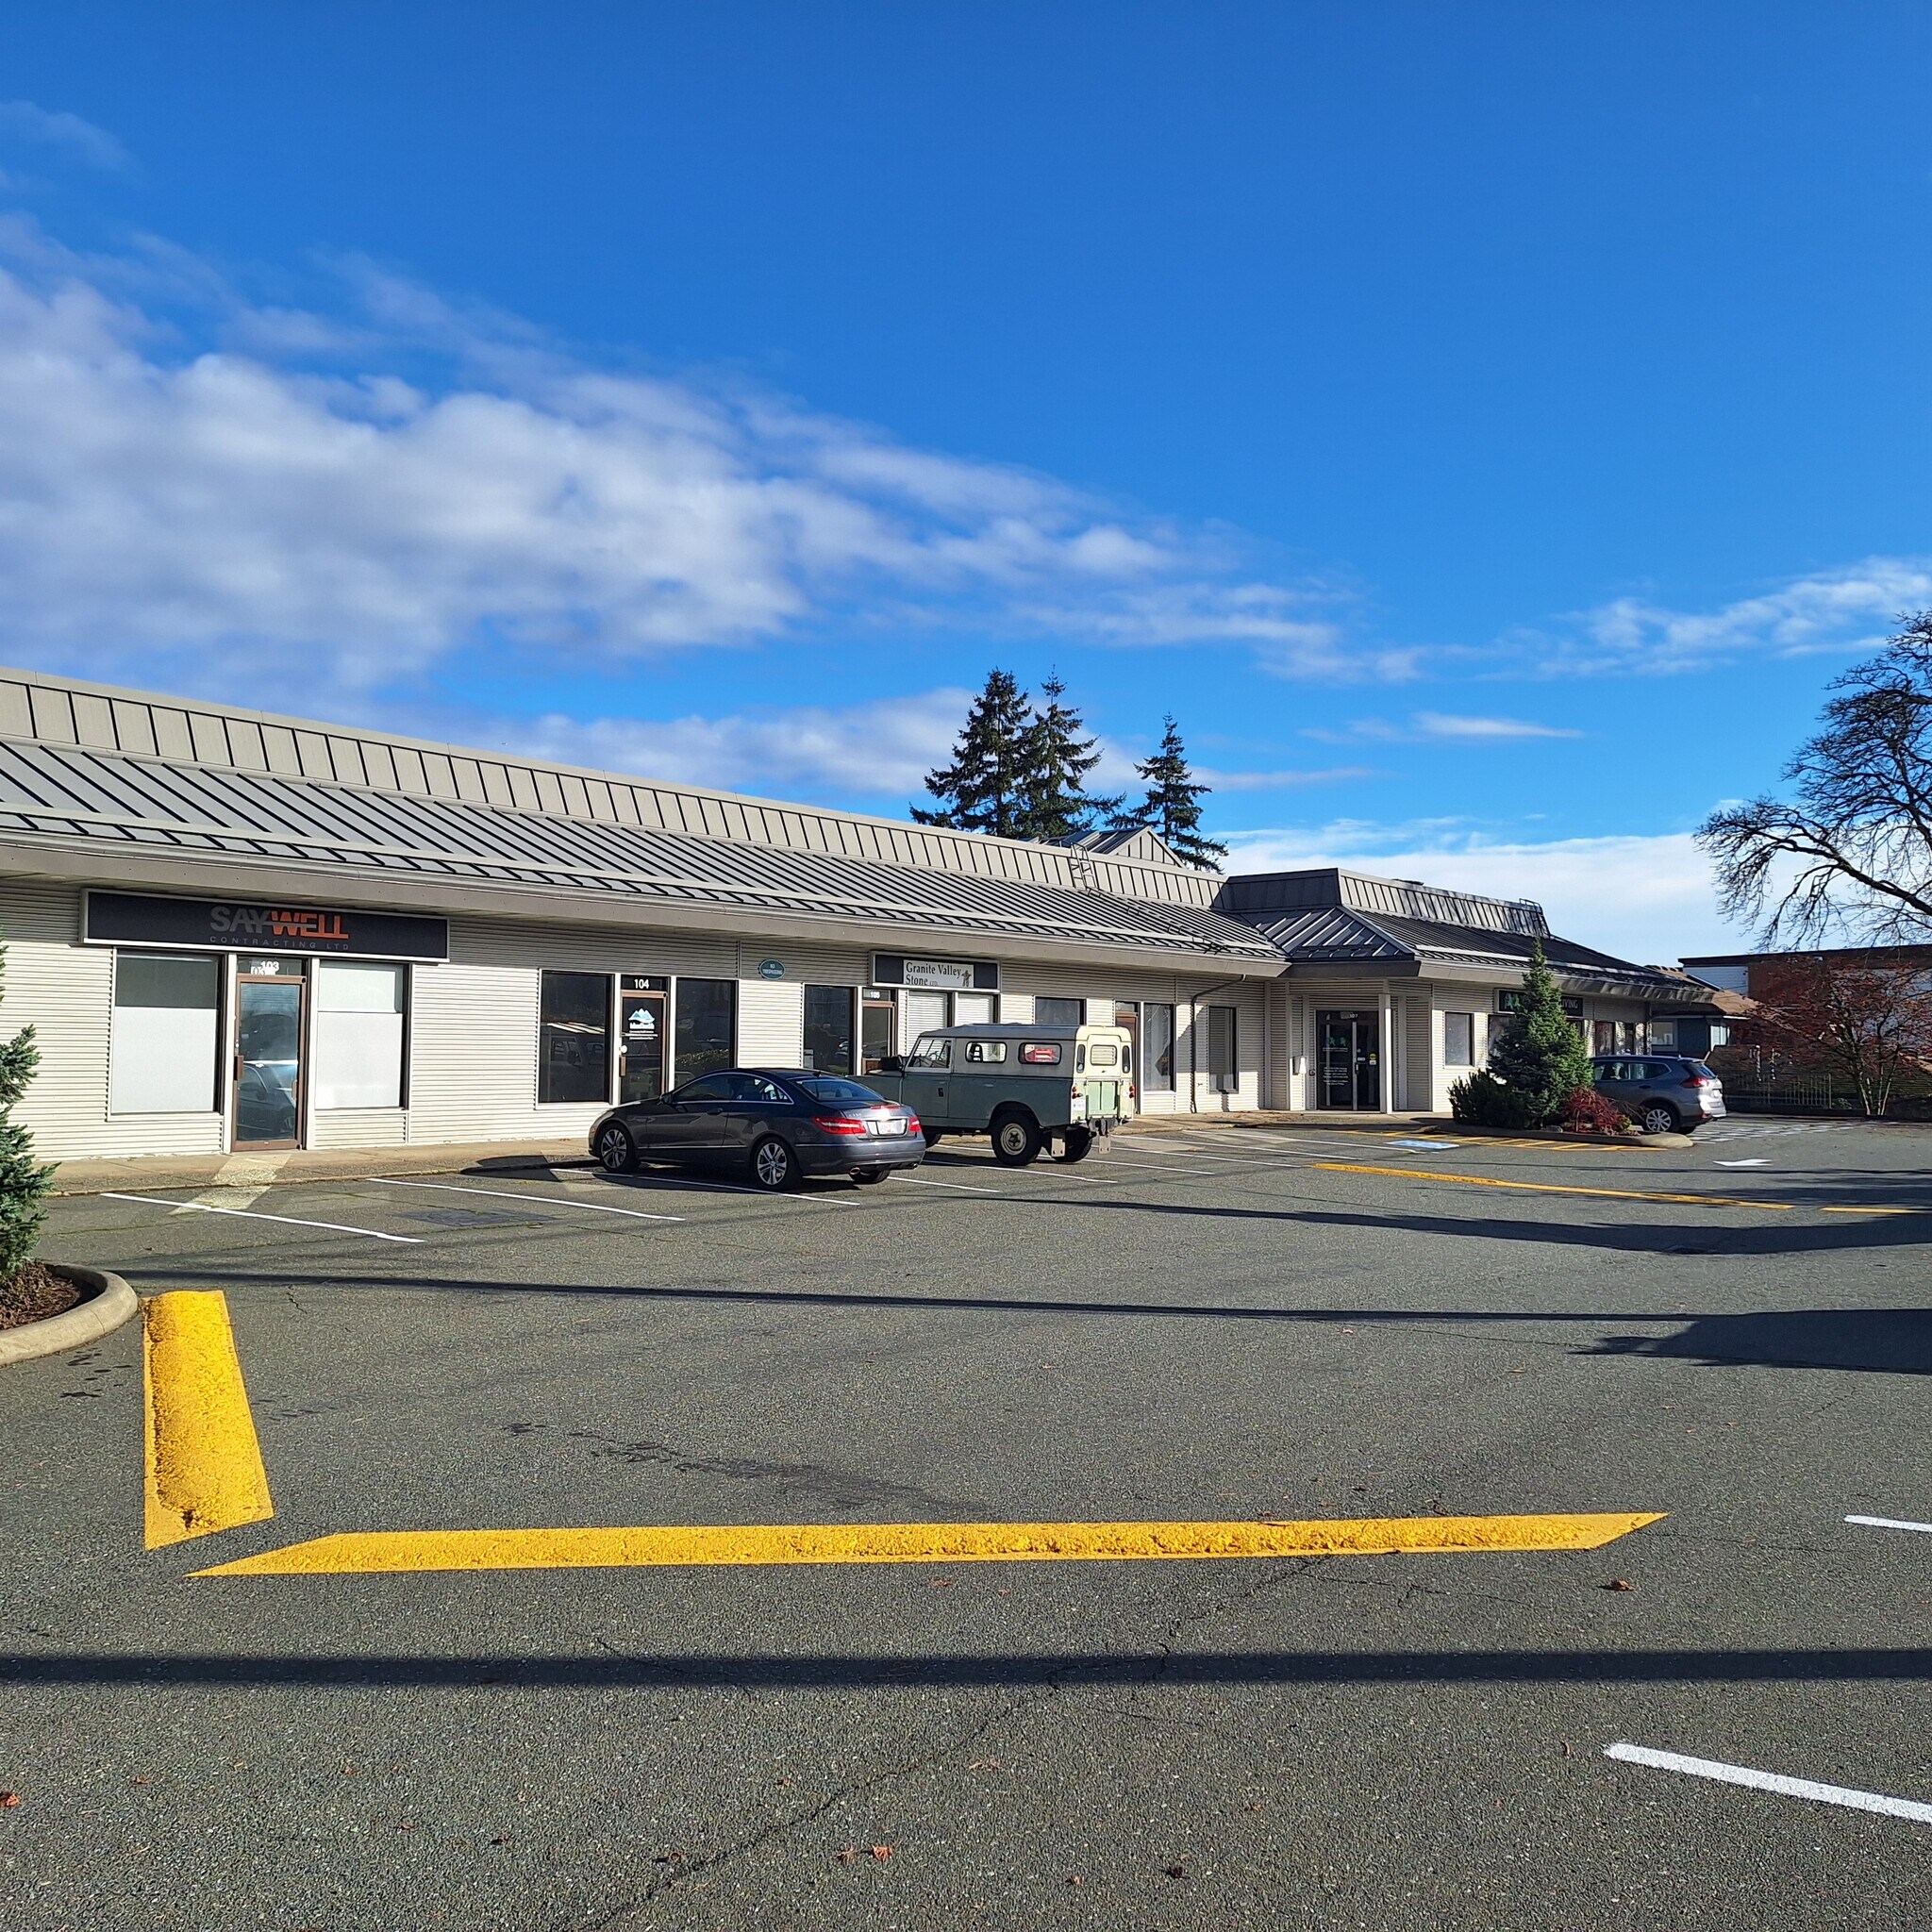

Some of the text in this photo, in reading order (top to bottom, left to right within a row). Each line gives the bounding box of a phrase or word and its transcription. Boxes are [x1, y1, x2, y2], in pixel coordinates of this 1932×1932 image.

[210, 906, 349, 940] SAYWELL
[209, 936, 316, 949] CONTRACTING
[260, 960, 280, 972] 103
[906, 961, 961, 979] Granite Valley
[634, 978, 650, 990] 104
[906, 974, 928, 986] Stone
